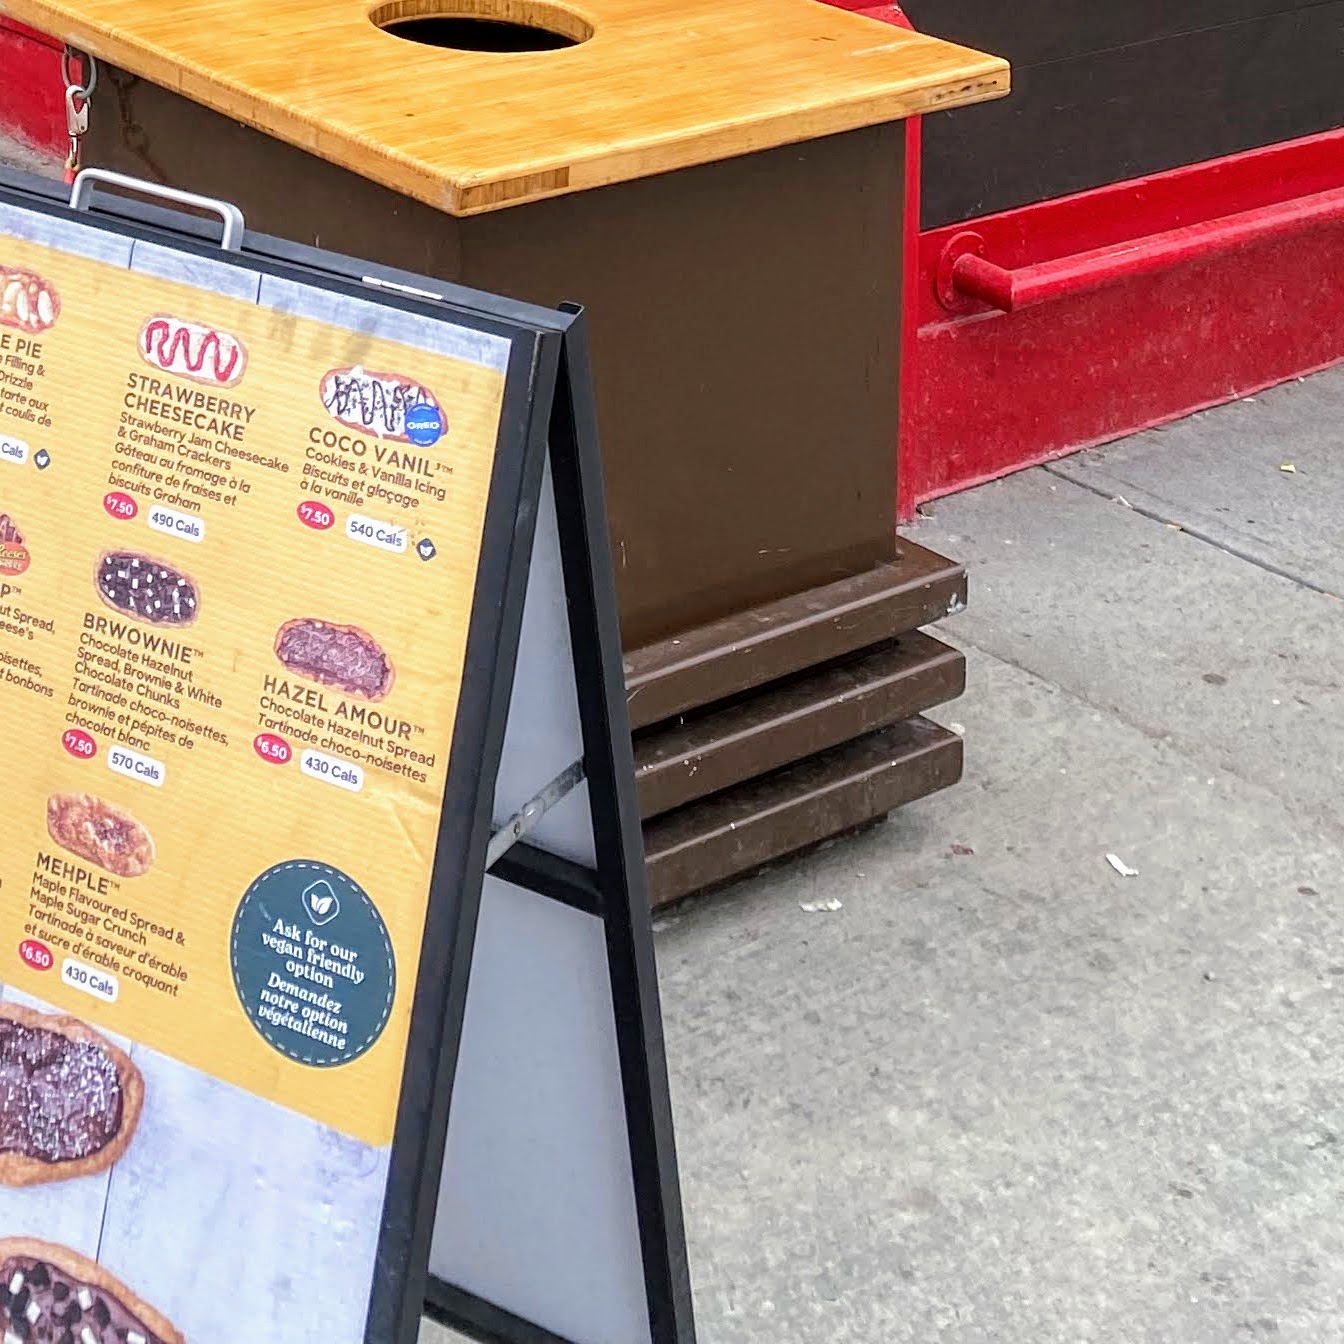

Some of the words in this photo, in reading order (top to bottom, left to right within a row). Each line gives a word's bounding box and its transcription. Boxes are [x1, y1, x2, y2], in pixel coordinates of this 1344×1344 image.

[4, 354, 35, 376] Filling
[35, 363, 45, 377] &
[14, 337, 42, 359] PIE
[123, 391, 245, 441] CHEESECAKE
[126, 372, 256, 423] STRAWBERRY
[0, 441, 23, 458] Cals
[116, 425, 127, 438] &
[128, 428, 175, 453] Graham
[176, 443, 231, 470] Crackers
[118, 410, 187, 444] Strawberry
[187, 431, 212, 449] Jam
[214, 439, 289, 473] Cheesecake
[308, 426, 367, 456] COCO
[305, 446, 355, 472] Cookies
[357, 461, 368, 476] &
[371, 465, 412, 488] Vanilla
[414, 478, 446, 501] Icing
[106, 495, 133, 515] $7.50
[151, 511, 174, 527] 490
[175, 518, 199, 536] Cals
[349, 520, 373, 537] 540
[79, 631, 139, 663] Chocolate
[140, 652, 193, 683] Hazelnut
[73, 660, 134, 692] Chocolate
[135, 682, 180, 709] Chunks
[122, 661, 172, 690] Brownie
[173, 680, 184, 695] &
[187, 684, 222, 708] White
[263, 673, 328, 712] HAZEL
[259, 695, 325, 728] Chocolate
[326, 718, 384, 750] Hazelnut
[386, 739, 435, 767] Spread
[111, 751, 133, 769] 570
[134, 760, 159, 780] Cals
[305, 756, 329, 774] 430
[330, 764, 358, 784] Cals
[261, 932, 303, 959] vegan
[306, 947, 364, 984] friendly
[272, 917, 301, 942] Ask
[304, 929, 328, 951] for
[329, 944, 358, 962] our
[65, 965, 87, 983] 430
[88, 975, 113, 996] Cals
[266, 971, 342, 1014] Demandez
[285, 959, 333, 988] option
[259, 988, 299, 1013] notre
[300, 1006, 347, 1034] option
